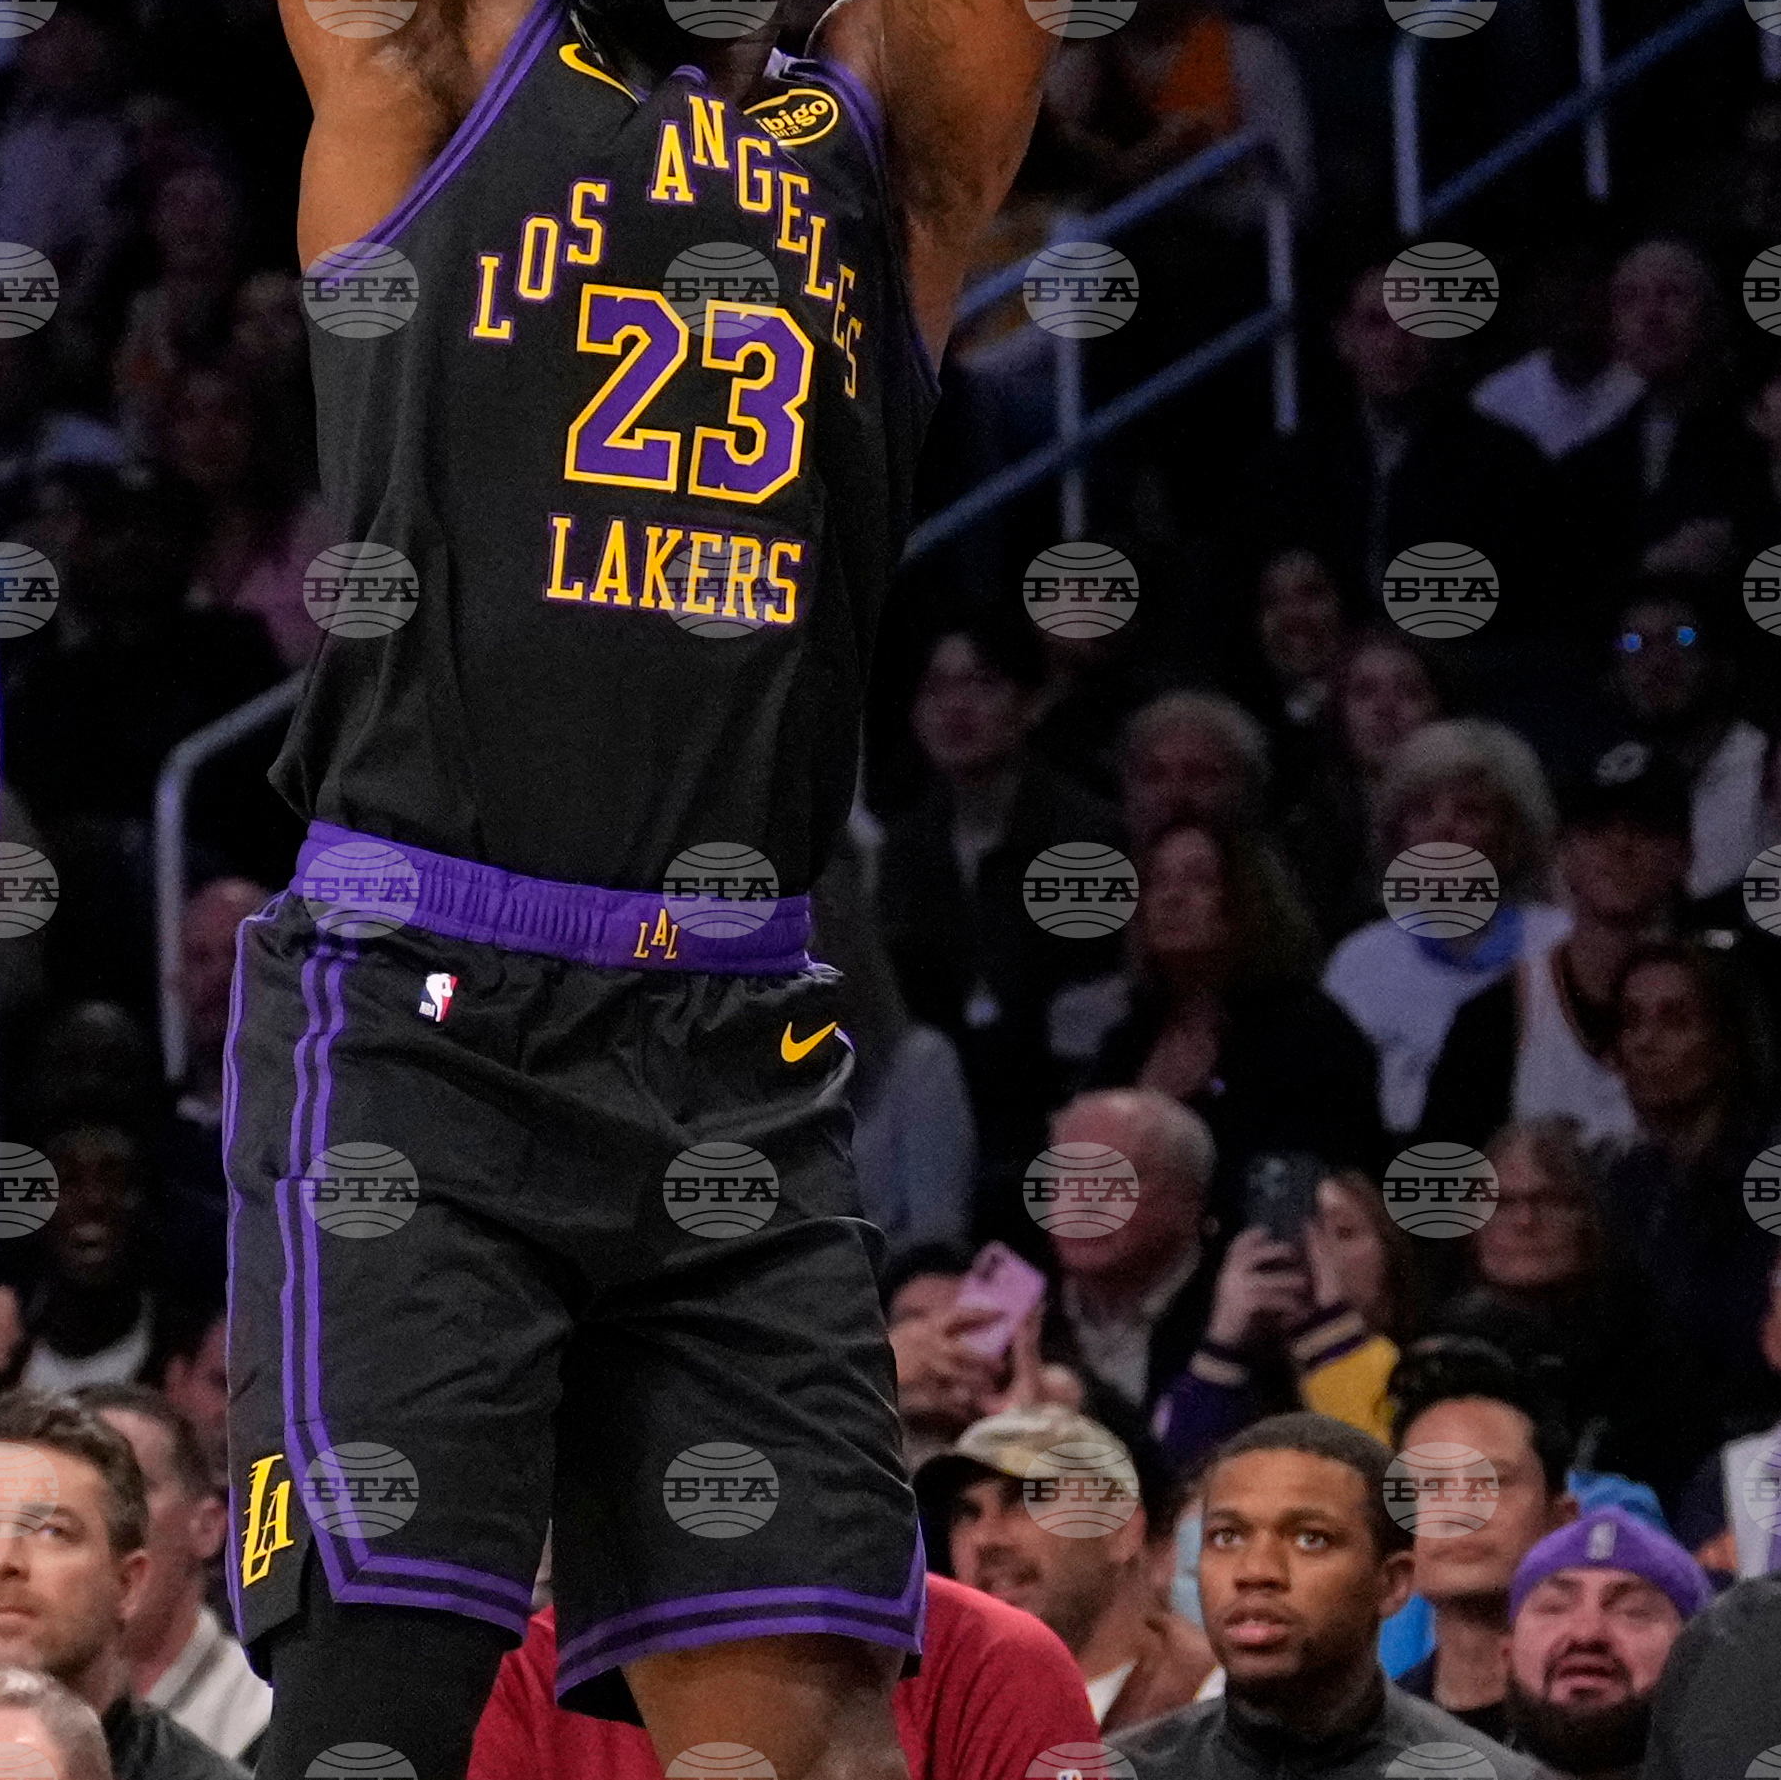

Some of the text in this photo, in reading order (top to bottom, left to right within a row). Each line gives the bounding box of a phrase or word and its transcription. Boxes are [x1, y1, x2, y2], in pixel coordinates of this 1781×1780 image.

[470, 94, 863, 401] LOS ANGELES
[564, 283, 814, 504] 23
[546, 517, 801, 624] LAKERS
[634, 908, 678, 960] LAL
[241, 1454, 295, 1587] LA
